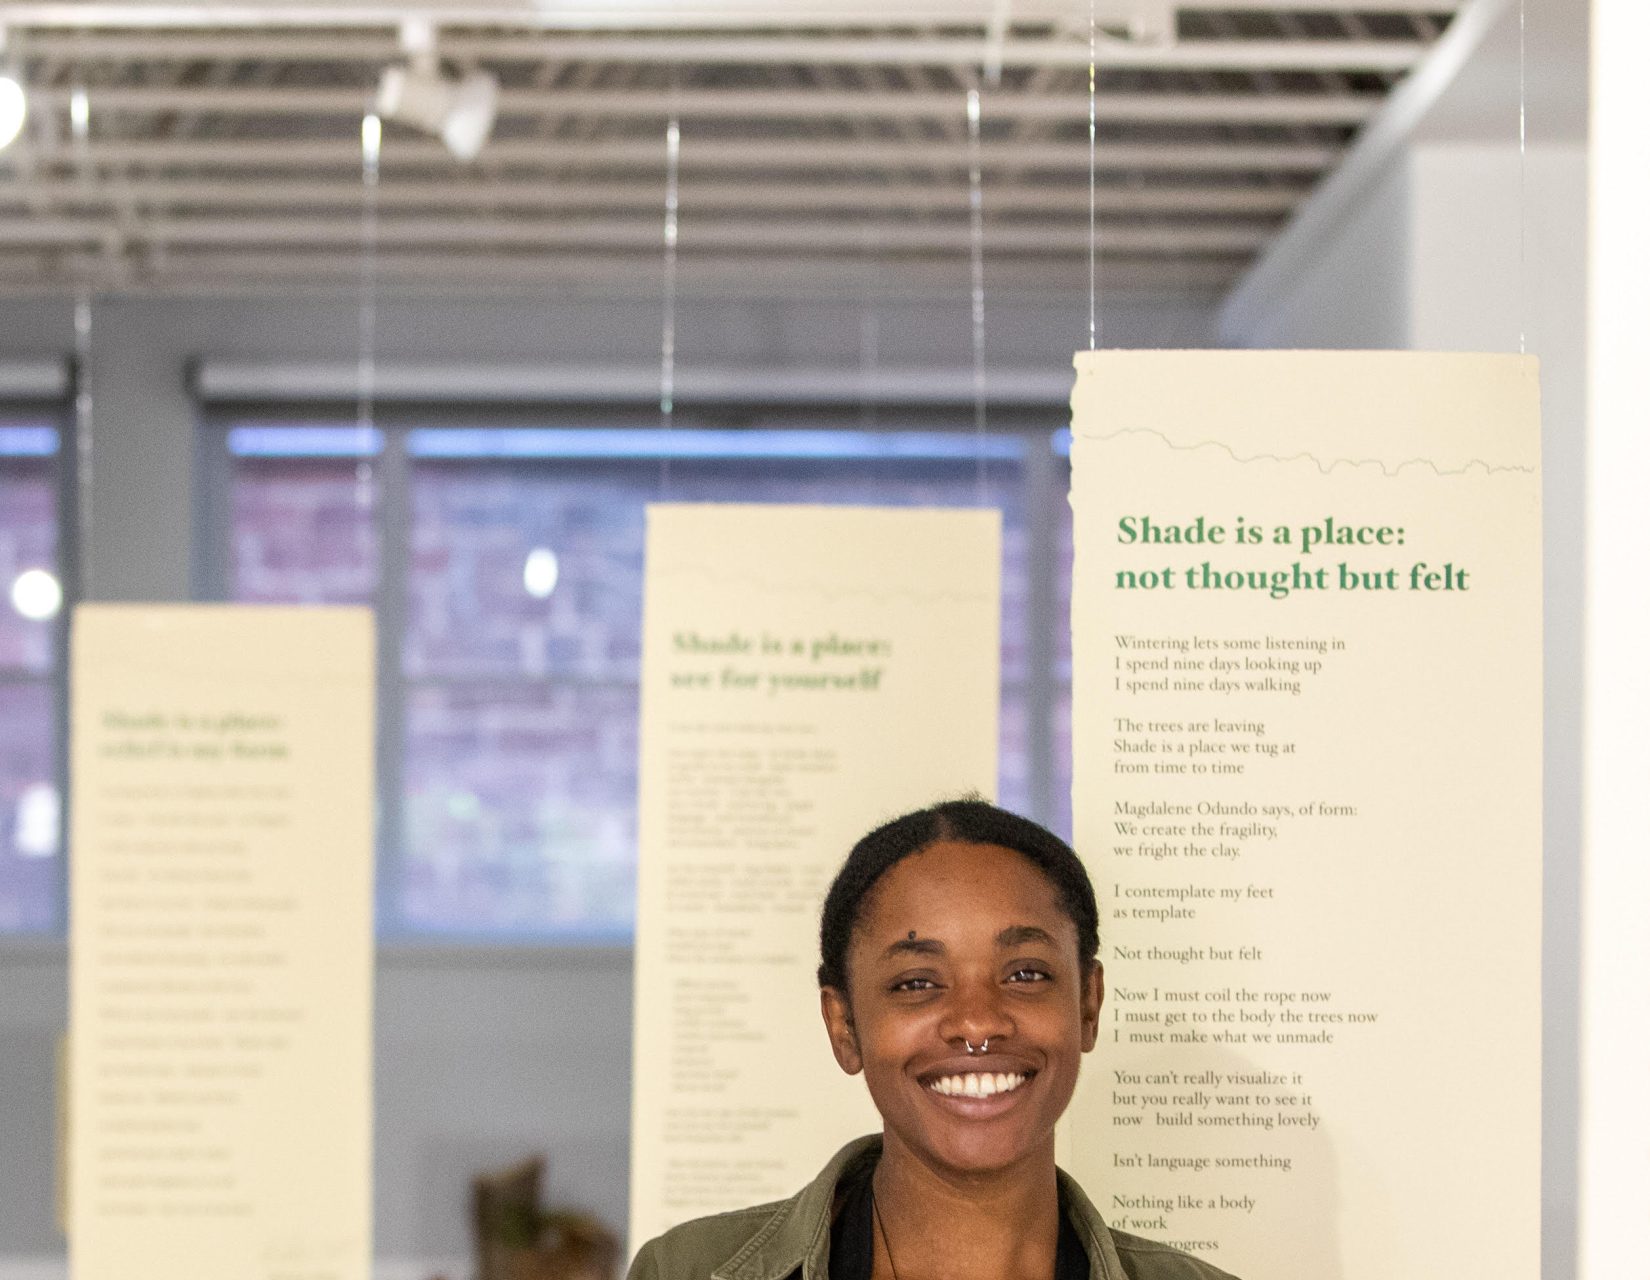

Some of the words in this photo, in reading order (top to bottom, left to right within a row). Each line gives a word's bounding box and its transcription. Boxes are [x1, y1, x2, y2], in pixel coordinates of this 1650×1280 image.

[1117, 515, 1226, 545] Shade
[1235, 515, 1264, 545] is
[1272, 525, 1292, 545] a
[1300, 516, 1405, 554] place:
[1115, 566, 1176, 590] not
[1184, 561, 1329, 600] thought
[1337, 562, 1400, 591] but
[1409, 562, 1470, 592] felt
[1113, 634, 1190, 654] Wintering
[1193, 635, 1219, 650] lets
[1222, 639, 1261, 650] some
[1265, 635, 1328, 655] listening
[1331, 635, 1346, 651] in
[1114, 655, 1121, 671] I
[1125, 655, 1169, 675] spend
[1173, 656, 1205, 671] nine
[1208, 655, 1241, 675] days
[1244, 655, 1300, 675] looking
[1303, 660, 1323, 676] up
[1114, 676, 1121, 691] I
[1125, 676, 1169, 696] spend
[1173, 678, 1205, 692] nine
[1208, 676, 1241, 696] days
[1244, 676, 1302, 696] walking
[1113, 717, 1144, 733] The
[1147, 721, 1184, 733] trees
[1187, 722, 1210, 733] are
[1214, 717, 1266, 737] leaving
[1113, 738, 1157, 753] Shade
[1161, 738, 1173, 753] is
[1176, 743, 1185, 753] a
[1188, 738, 1227, 758] place
[1230, 743, 1251, 754] we
[1254, 742, 1279, 758] tug
[1282, 743, 1296, 754] at
[1114, 759, 1150, 774] from
[1153, 759, 1188, 775] time
[1191, 763, 1208, 774] to
[1211, 759, 1245, 775] time
[1114, 800, 1193, 820] Magdalene
[1197, 800, 1258, 816] Odundo
[1261, 805, 1295, 821] says,
[1298, 801, 1316, 816] of
[1318, 801, 1358, 817] form:
[1113, 821, 1138, 836] We
[1142, 825, 1187, 836] create
[1191, 821, 1215, 837] the
[1219, 821, 1278, 840] fragility,
[1112, 846, 1134, 857] we
[1138, 842, 1178, 861] fright
[1183, 842, 1208, 857] the
[1113, 883, 1121, 898] I
[1124, 883, 1216, 903] contemplate
[1220, 888, 1243, 903] my
[1246, 884, 1274, 899] feet
[1112, 908, 1128, 919] as
[1131, 904, 1196, 924] template
[1113, 945, 1142, 961] Not
[1146, 945, 1205, 965] thought
[1208, 945, 1234, 961] but
[1238, 945, 1262, 961] felt
[1113, 987, 1149, 1002] Now
[1152, 987, 1160, 1002] I
[1164, 991, 1200, 1002] must
[1204, 987, 1231, 1002] coil
[1235, 987, 1259, 1002] the
[1263, 991, 1297, 1007] rope
[1300, 991, 1332, 1003] now
[1113, 1008, 1120, 1023] I
[1125, 1012, 1160, 1023] must
[1164, 1012, 1187, 1028] get
[1192, 1011, 1208, 1023] to
[1211, 1008, 1236, 1023] the
[1239, 1007, 1276, 1028] body
[1279, 1008, 1304, 1024] the
[1308, 1012, 1344, 1024] trees
[1347, 1013, 1379, 1023] now
[1112, 1028, 1120, 1044] I
[1129, 1031, 1165, 1044] must
[1169, 1028, 1208, 1044] make
[1212, 1029, 1247, 1043] what
[1251, 1033, 1272, 1044] we
[1276, 1029, 1334, 1044] unmade
[1113, 1069, 1141, 1085] You
[1183, 1069, 1223, 1089] really
[1226, 1070, 1288, 1085] visualize
[1292, 1071, 1302, 1085] it
[1112, 1090, 1137, 1106] but
[1141, 1095, 1168, 1110] you
[1172, 1091, 1212, 1110] really
[1215, 1095, 1250, 1106] want
[1255, 1095, 1271, 1106] to
[1274, 1095, 1298, 1106] see
[1301, 1091, 1313, 1106] it
[1112, 1115, 1143, 1126] now
[1155, 1111, 1193, 1127] build
[1197, 1111, 1274, 1131] something
[1277, 1111, 1321, 1131] lovely
[1147, 1153, 1211, 1172] language
[1214, 1153, 1292, 1173] something
[1112, 1194, 1174, 1214] Nothing
[1177, 1194, 1204, 1209] like
[1207, 1199, 1216, 1209] a
[1219, 1194, 1256, 1214] body
[1111, 1215, 1128, 1230] of
[1130, 1215, 1168, 1230] work
